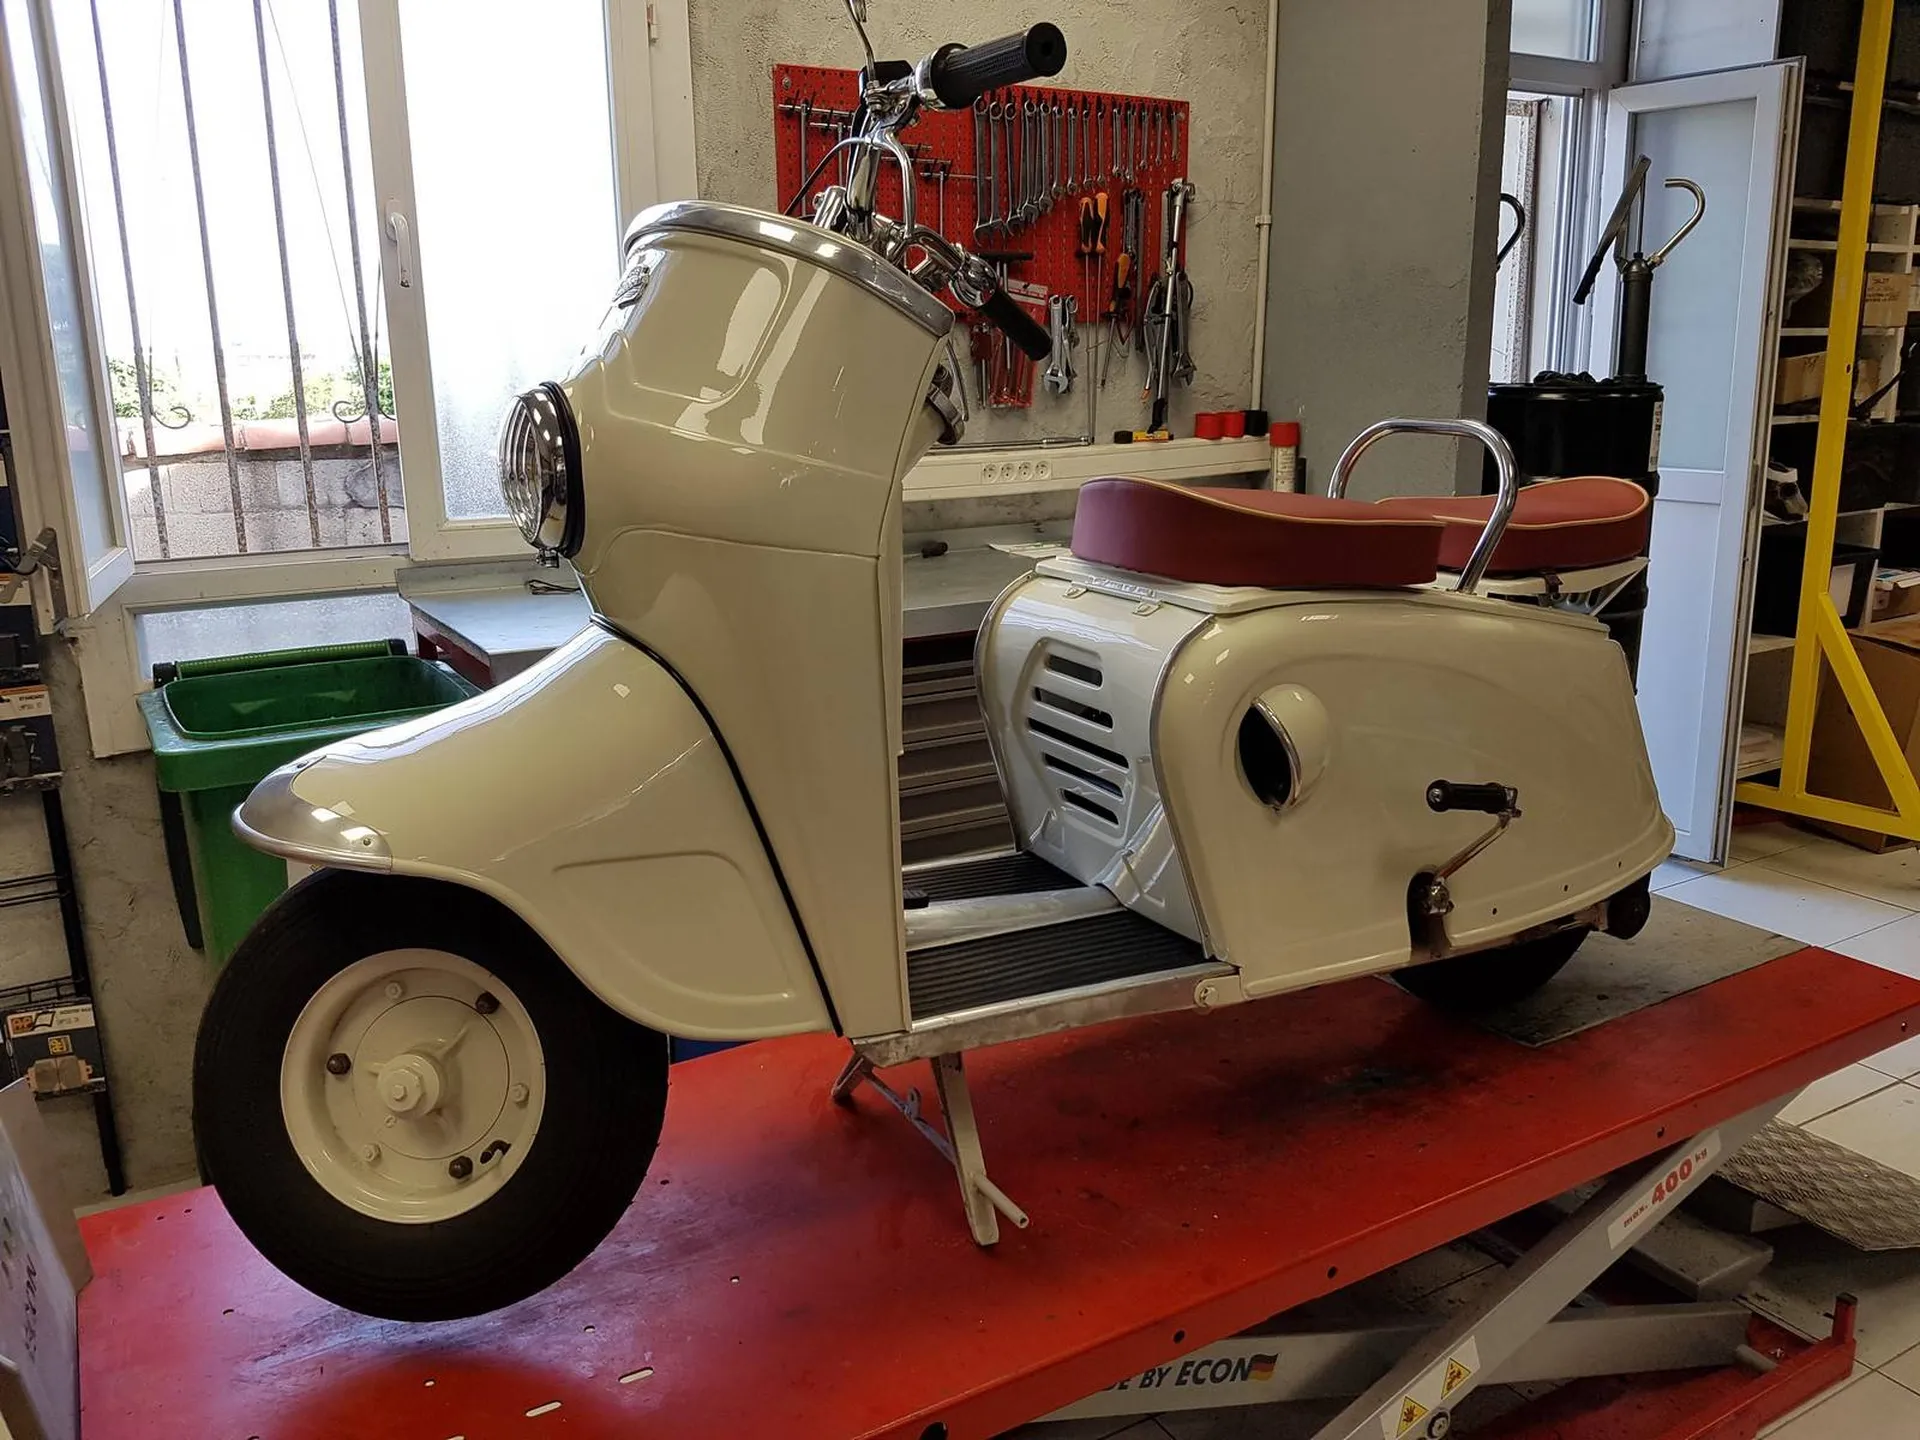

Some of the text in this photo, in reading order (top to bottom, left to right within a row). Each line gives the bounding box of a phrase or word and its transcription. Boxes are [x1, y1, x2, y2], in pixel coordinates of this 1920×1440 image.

[1623, 1148, 1707, 1228] max. 400 kg
[1139, 1366, 1172, 1389] BY
[1175, 1357, 1251, 1386] ECON
